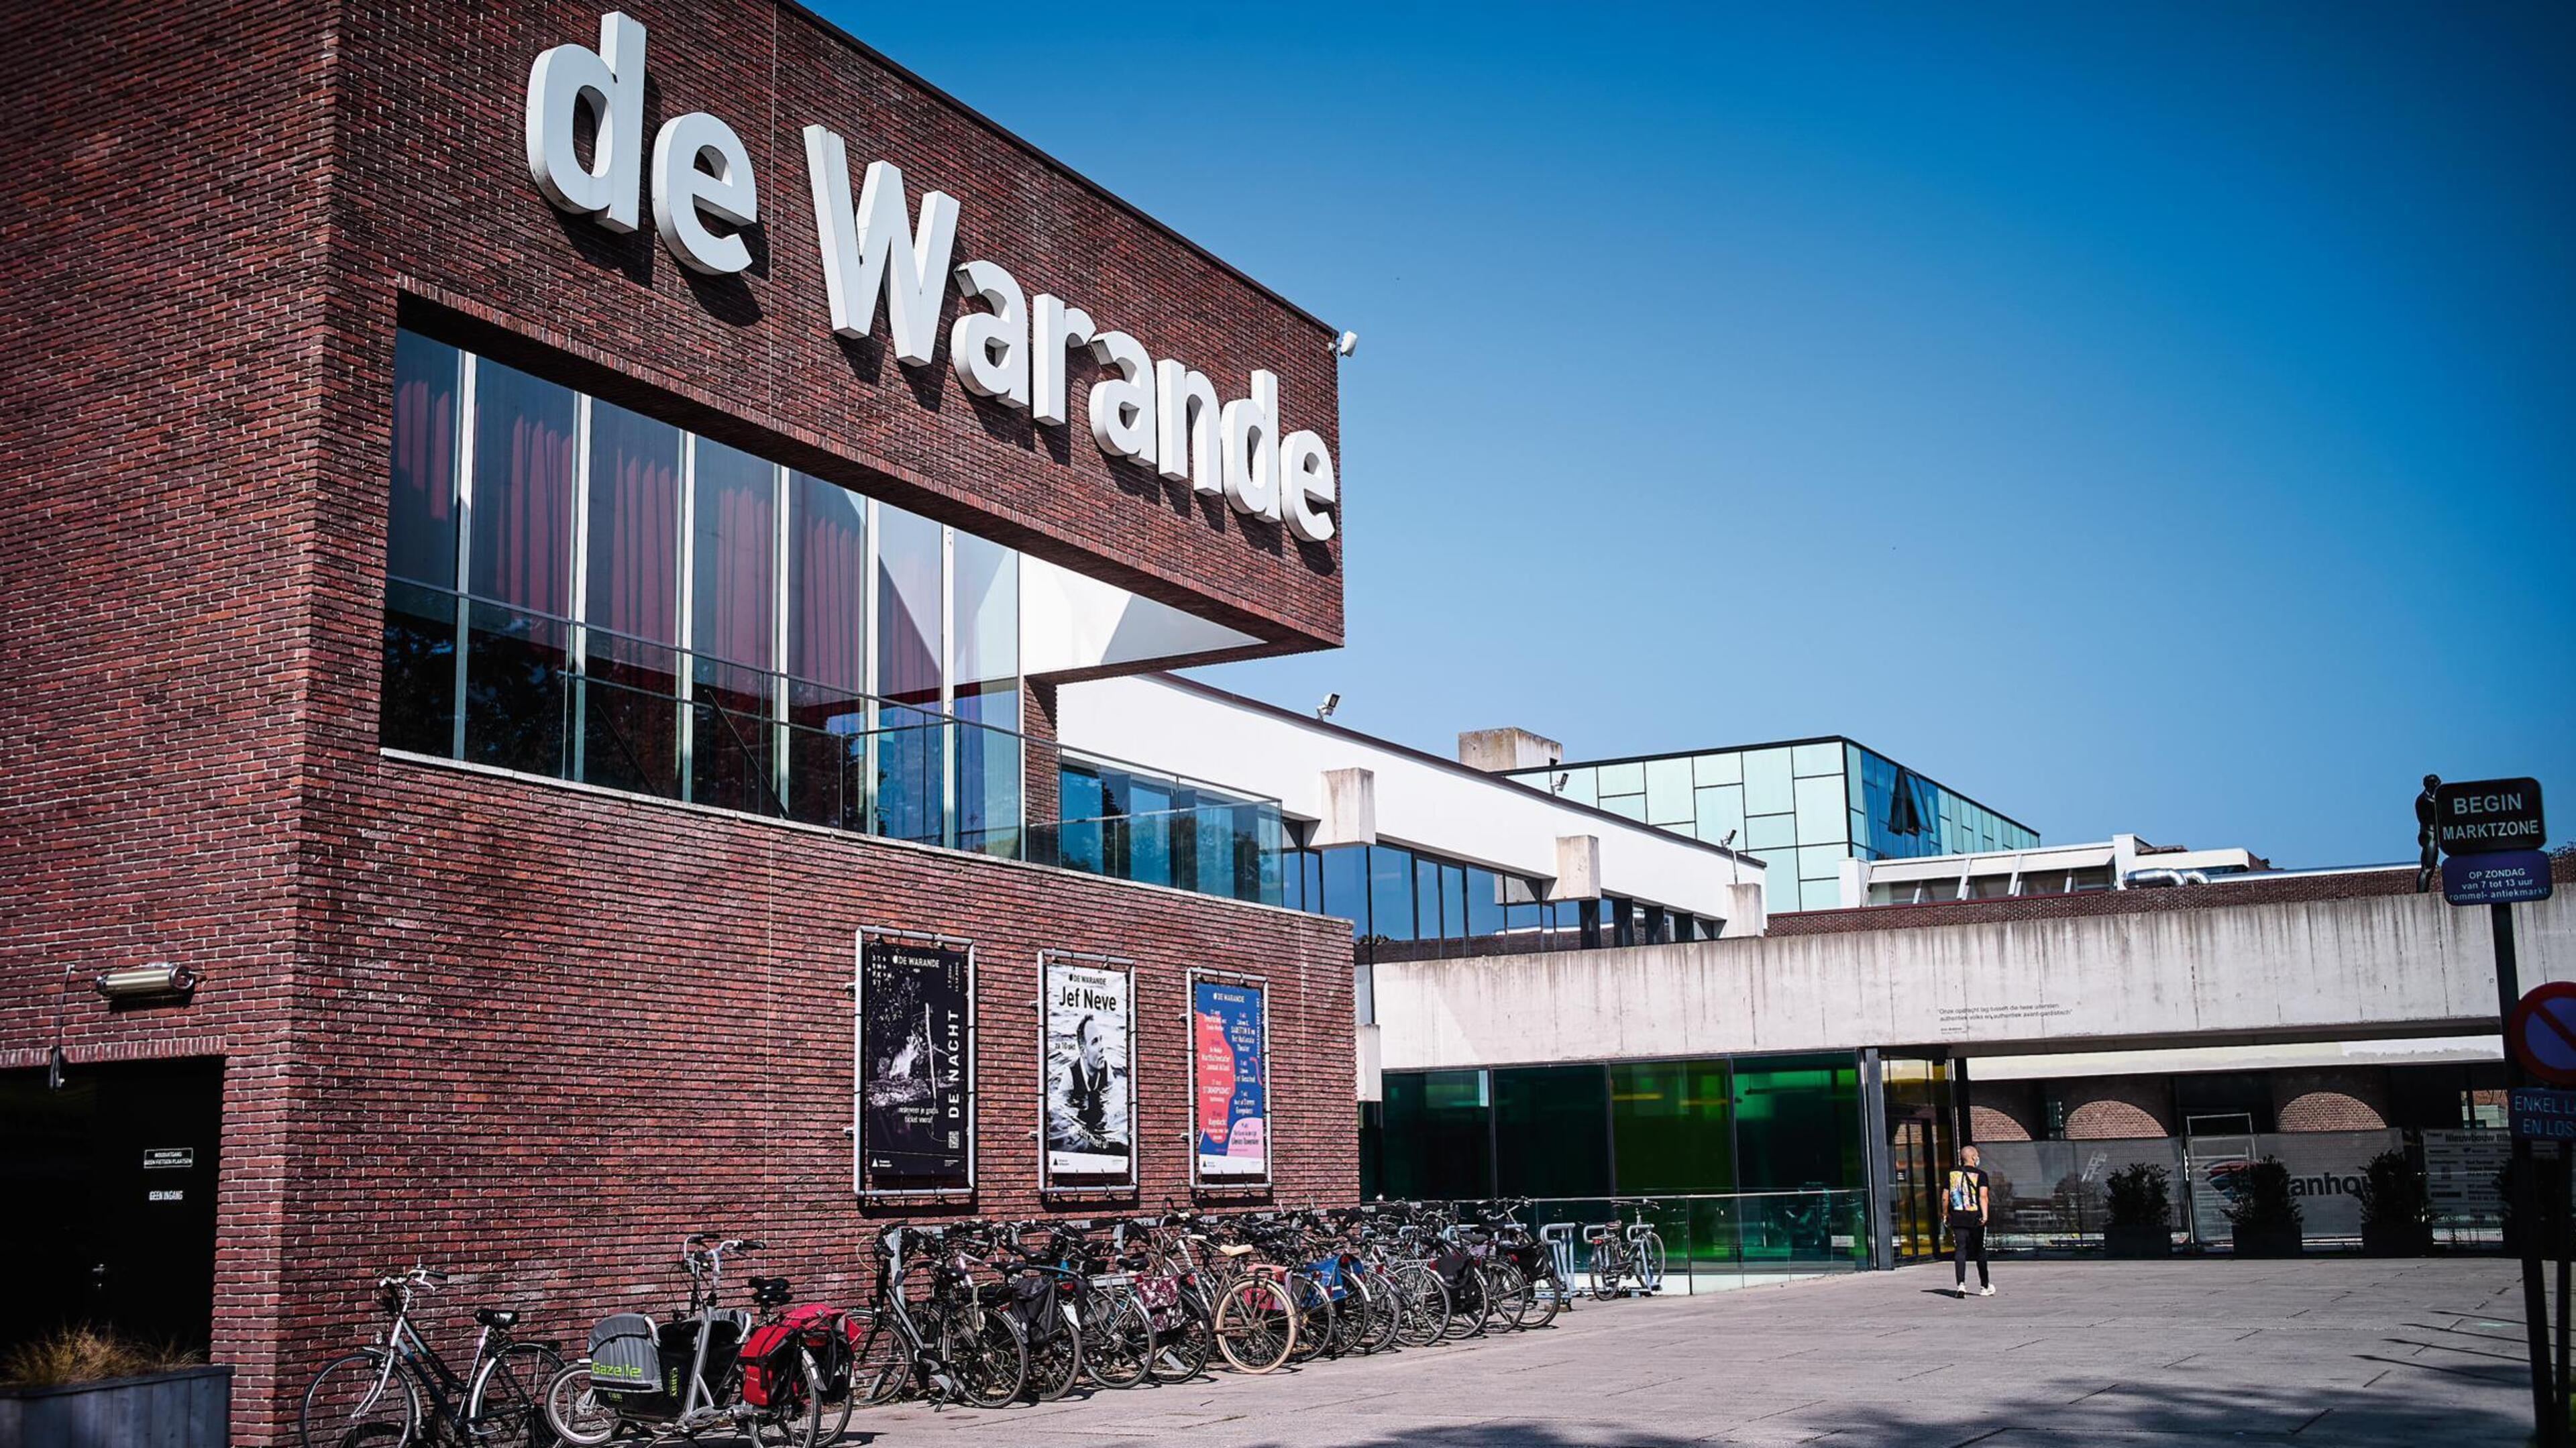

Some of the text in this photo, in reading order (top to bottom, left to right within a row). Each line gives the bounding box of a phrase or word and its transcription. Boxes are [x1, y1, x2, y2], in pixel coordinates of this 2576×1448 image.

[526, 11, 1336, 543] de Warande
[2453, 793, 2522, 815] BEGIN
[2443, 820, 2539, 840] MARKTZONE
[2469, 868, 2526, 879] OP ZONDAG
[2481, 881, 2486, 889] 7
[2489, 880, 2502, 889] tot
[2449, 887, 2548, 901] rommel- antiekmarkt
[899, 956, 940, 968] DE WARANDE
[1073, 974, 1107, 985] DE WARANDE
[1059, 986, 1117, 1011] Jef Neve
[1224, 994, 1245, 1003] WARANDE
[948, 1010, 959, 1118] DE NACHT
[2514, 1095, 2576, 1114] ENKEL L
[2523, 1118, 2576, 1137] EN LOS
[2446, 1133, 2495, 1143] Nieuwbouw
[149, 1190, 183, 1201] GEEN INGANG
[592, 1361, 643, 1378] Gazelle
